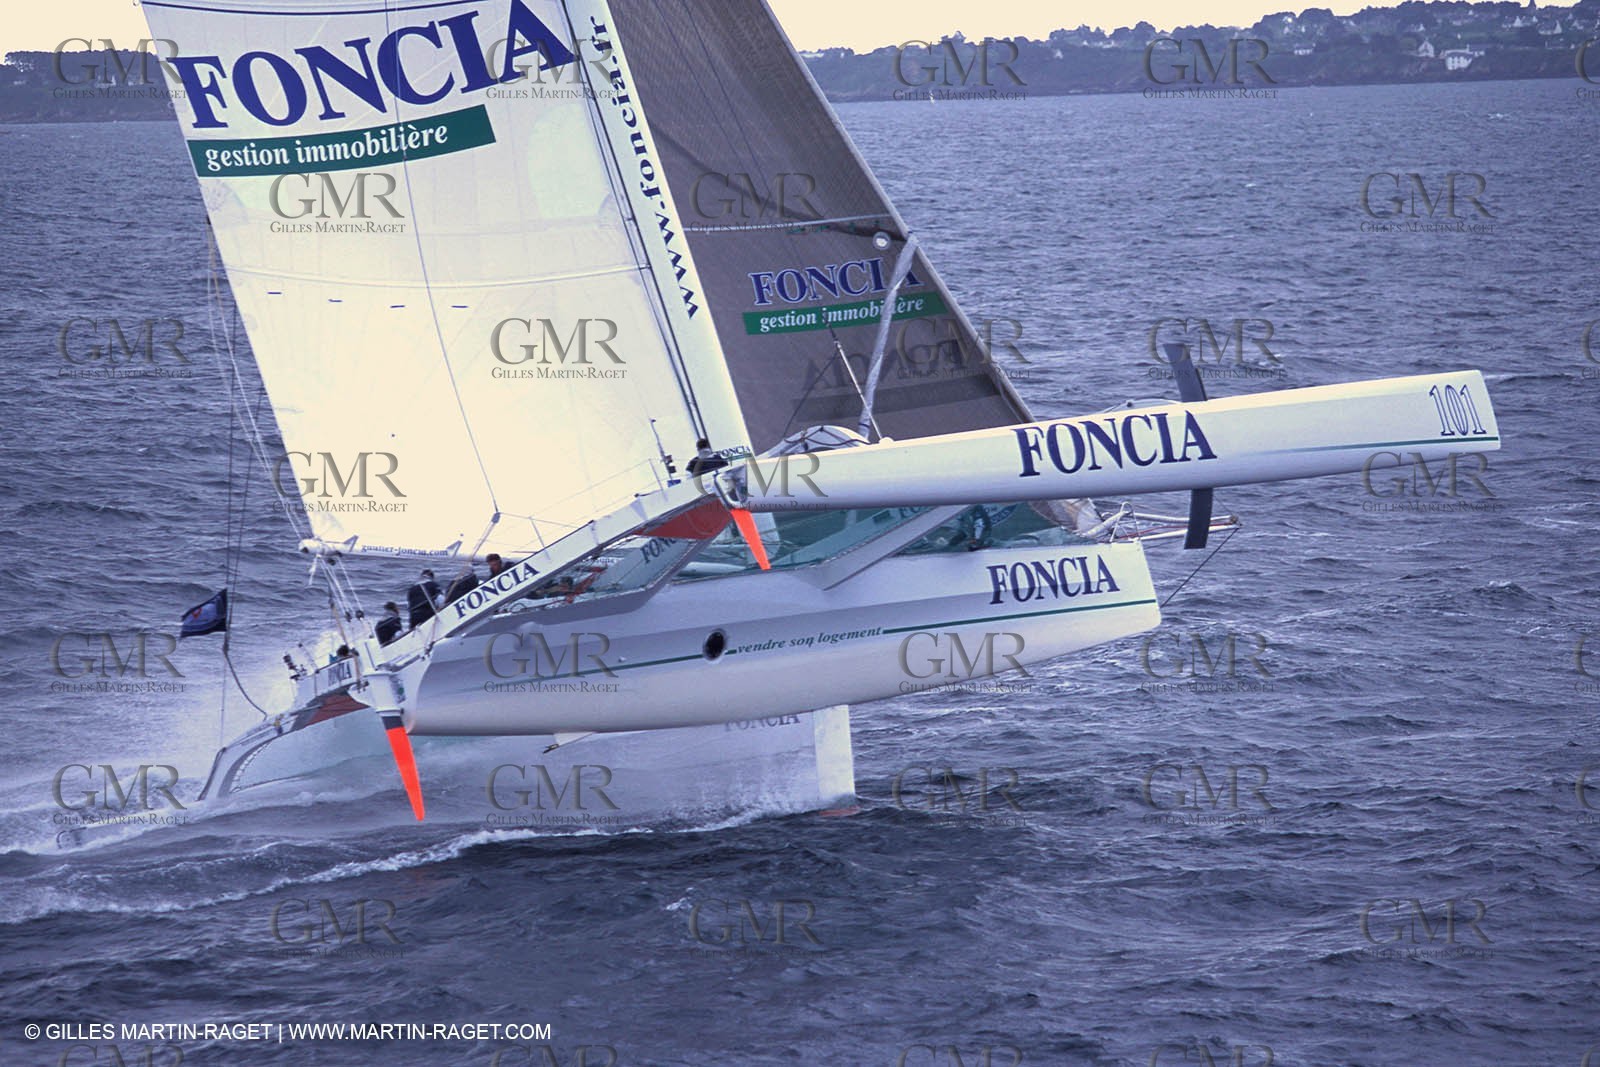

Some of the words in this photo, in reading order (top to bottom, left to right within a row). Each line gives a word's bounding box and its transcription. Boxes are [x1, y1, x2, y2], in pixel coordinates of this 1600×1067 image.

[166, 0, 577, 128] FONCIA
[205, 140, 290, 172] gestion
[297, 123, 449, 164] immobilière
[759, 310, 817, 332] gestion
[821, 297, 925, 325] immobière
[1429, 384, 1488, 436] 101
[1010, 410, 1218, 477] FONCIA
[453, 562, 540, 619] FONCIA
[986, 554, 1120, 605] FONCIA
[737, 639, 786, 654] vendre
[817, 626, 883, 644] logement
